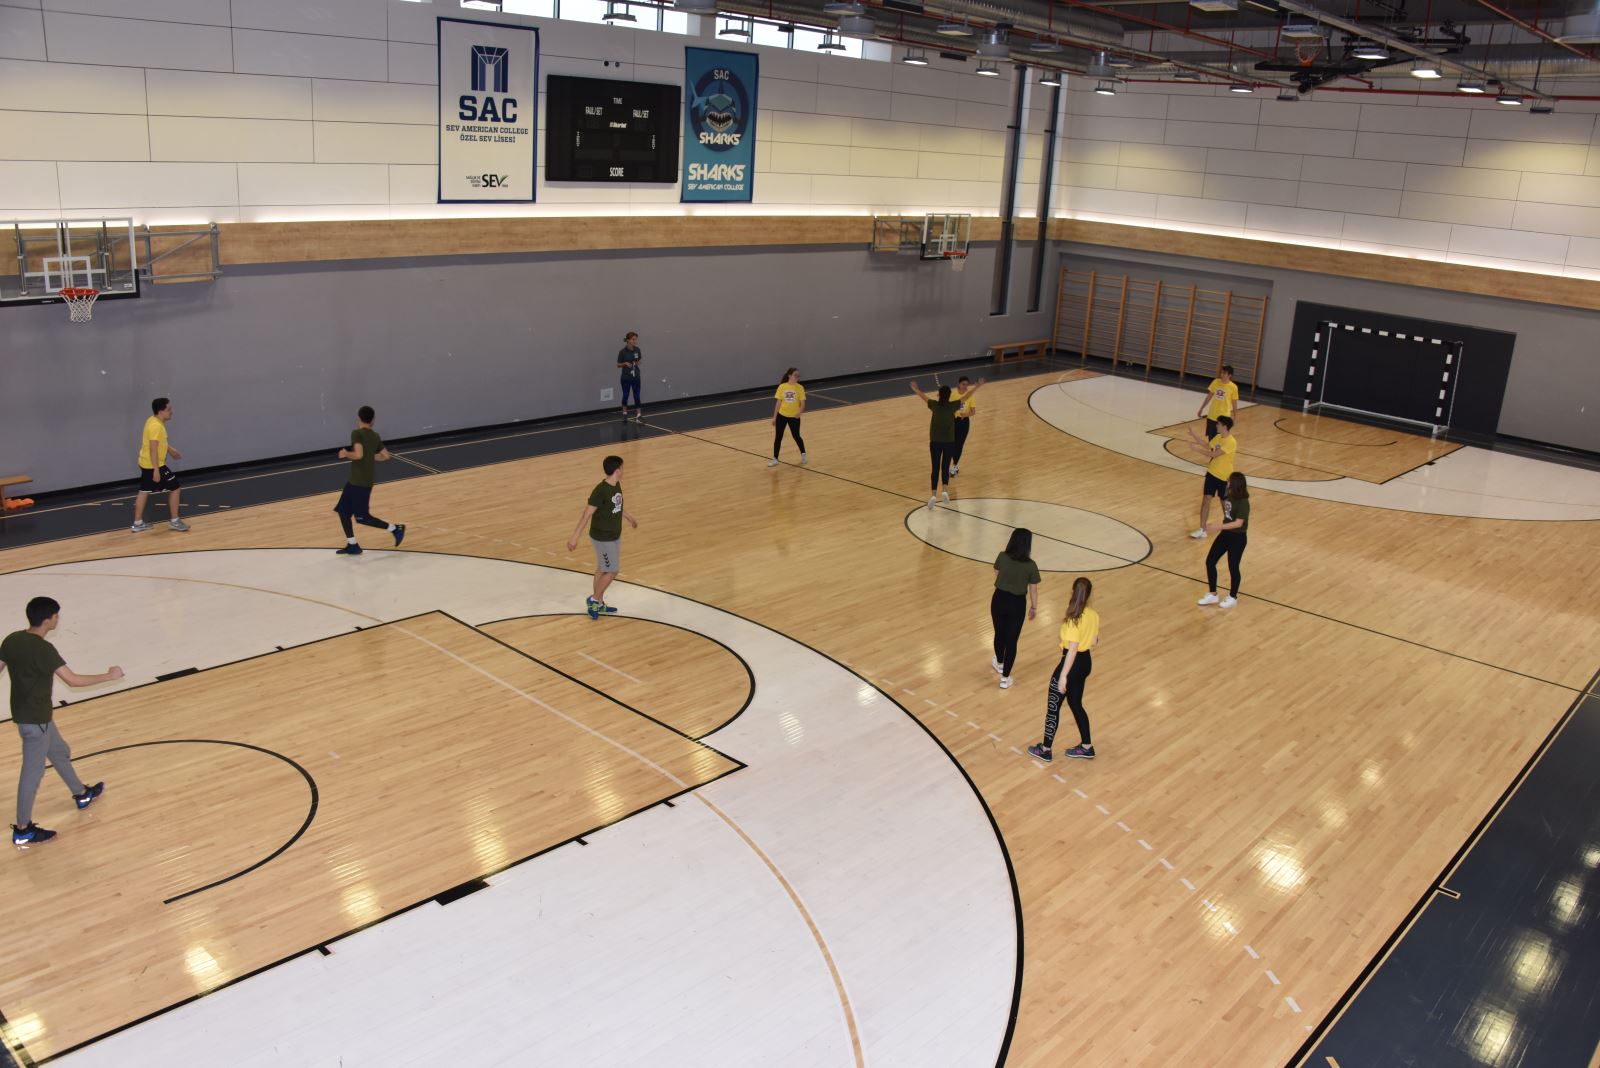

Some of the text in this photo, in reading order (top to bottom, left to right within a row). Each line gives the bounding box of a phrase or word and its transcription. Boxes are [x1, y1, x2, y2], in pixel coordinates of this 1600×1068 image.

[714, 69, 729, 80] SAC
[459, 95, 517, 123] SAC
[460, 133, 478, 142] ÖZEL
[499, 127, 528, 135] COLLEGE
[699, 132, 741, 145] SHARKS
[609, 167, 624, 177] SCORE
[688, 163, 746, 181] SHARKS
[481, 174, 509, 188] SEV
[1048, 693, 1059, 711] DO
[1045, 714, 1056, 740] JUST
